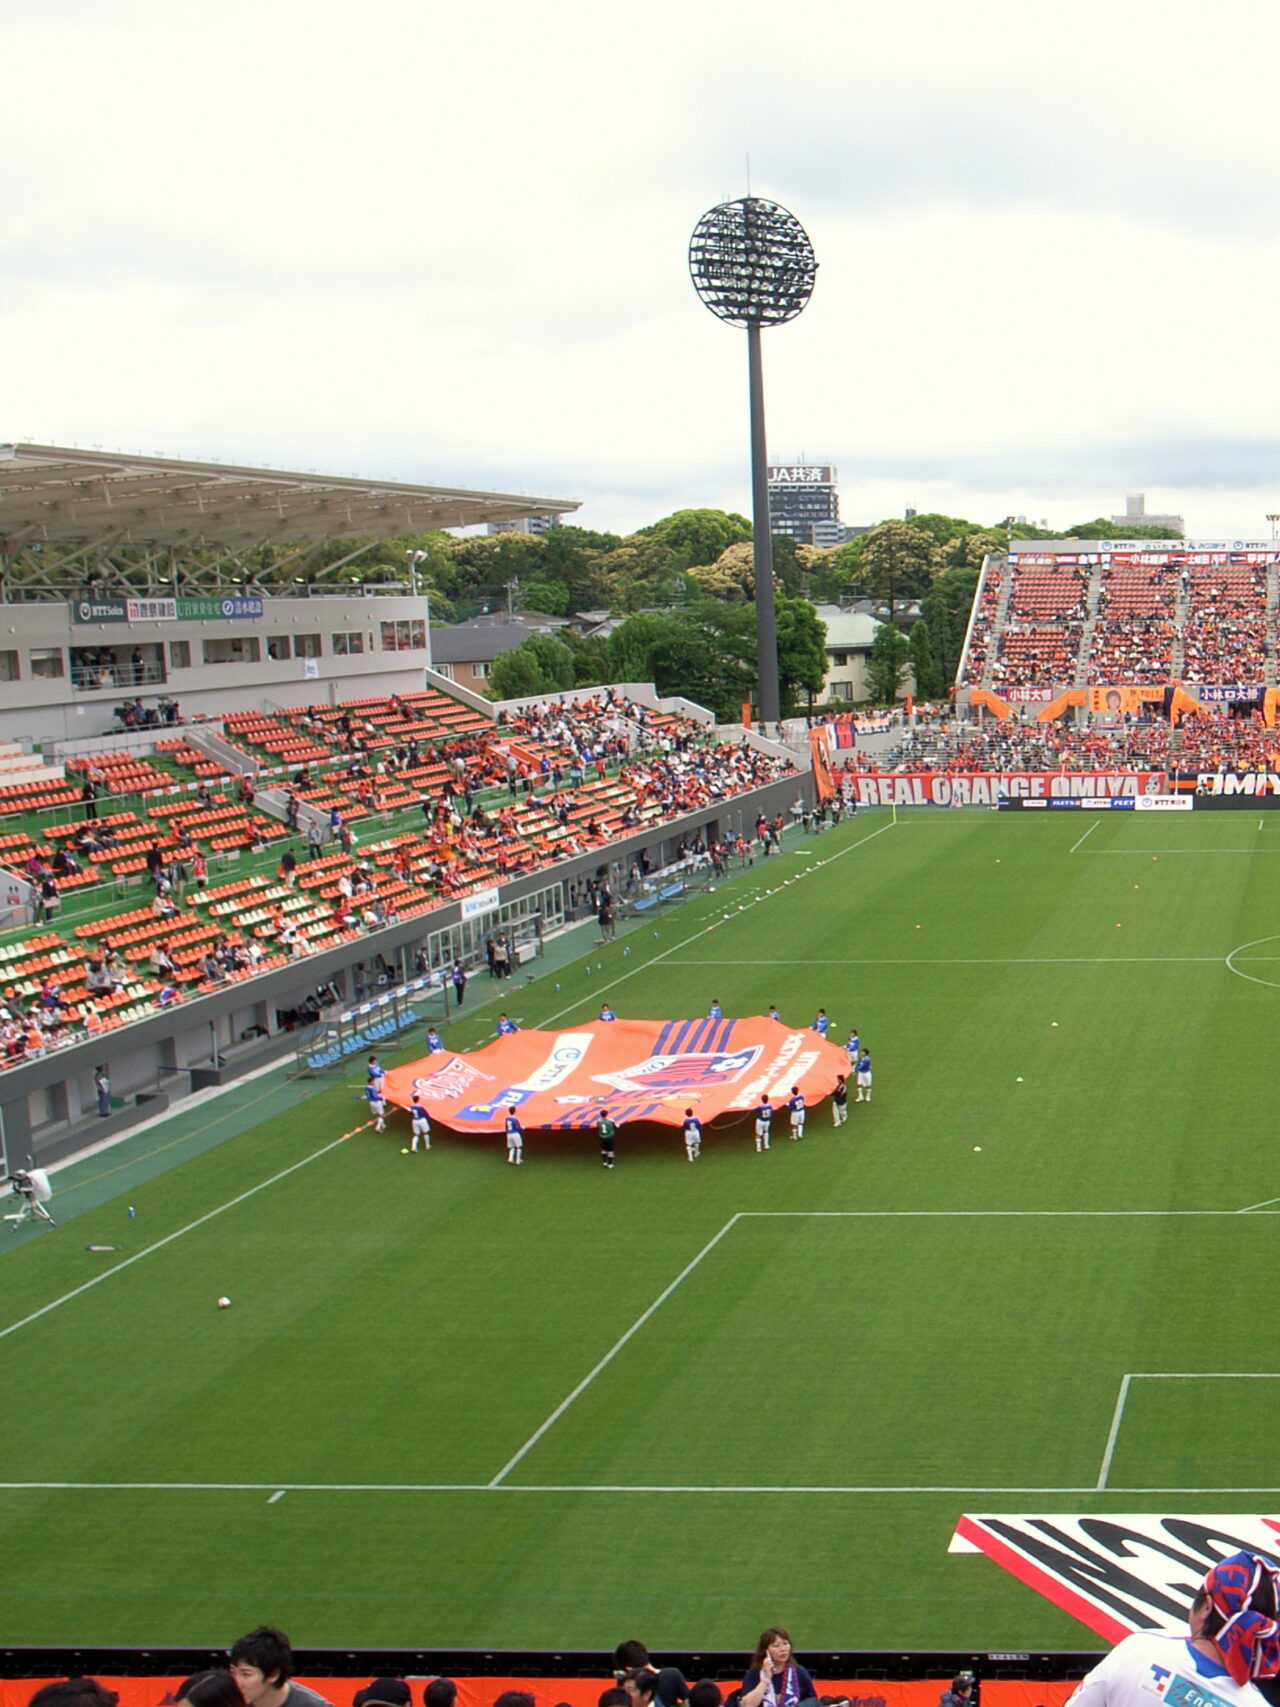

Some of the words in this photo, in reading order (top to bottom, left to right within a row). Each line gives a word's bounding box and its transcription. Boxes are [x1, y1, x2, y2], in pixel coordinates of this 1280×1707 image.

[767, 467, 823, 482] JA共済
[857, 777, 928, 805] REAL
[931, 776, 1046, 805] ORANGE
[1050, 775, 1140, 798] OMIYA
